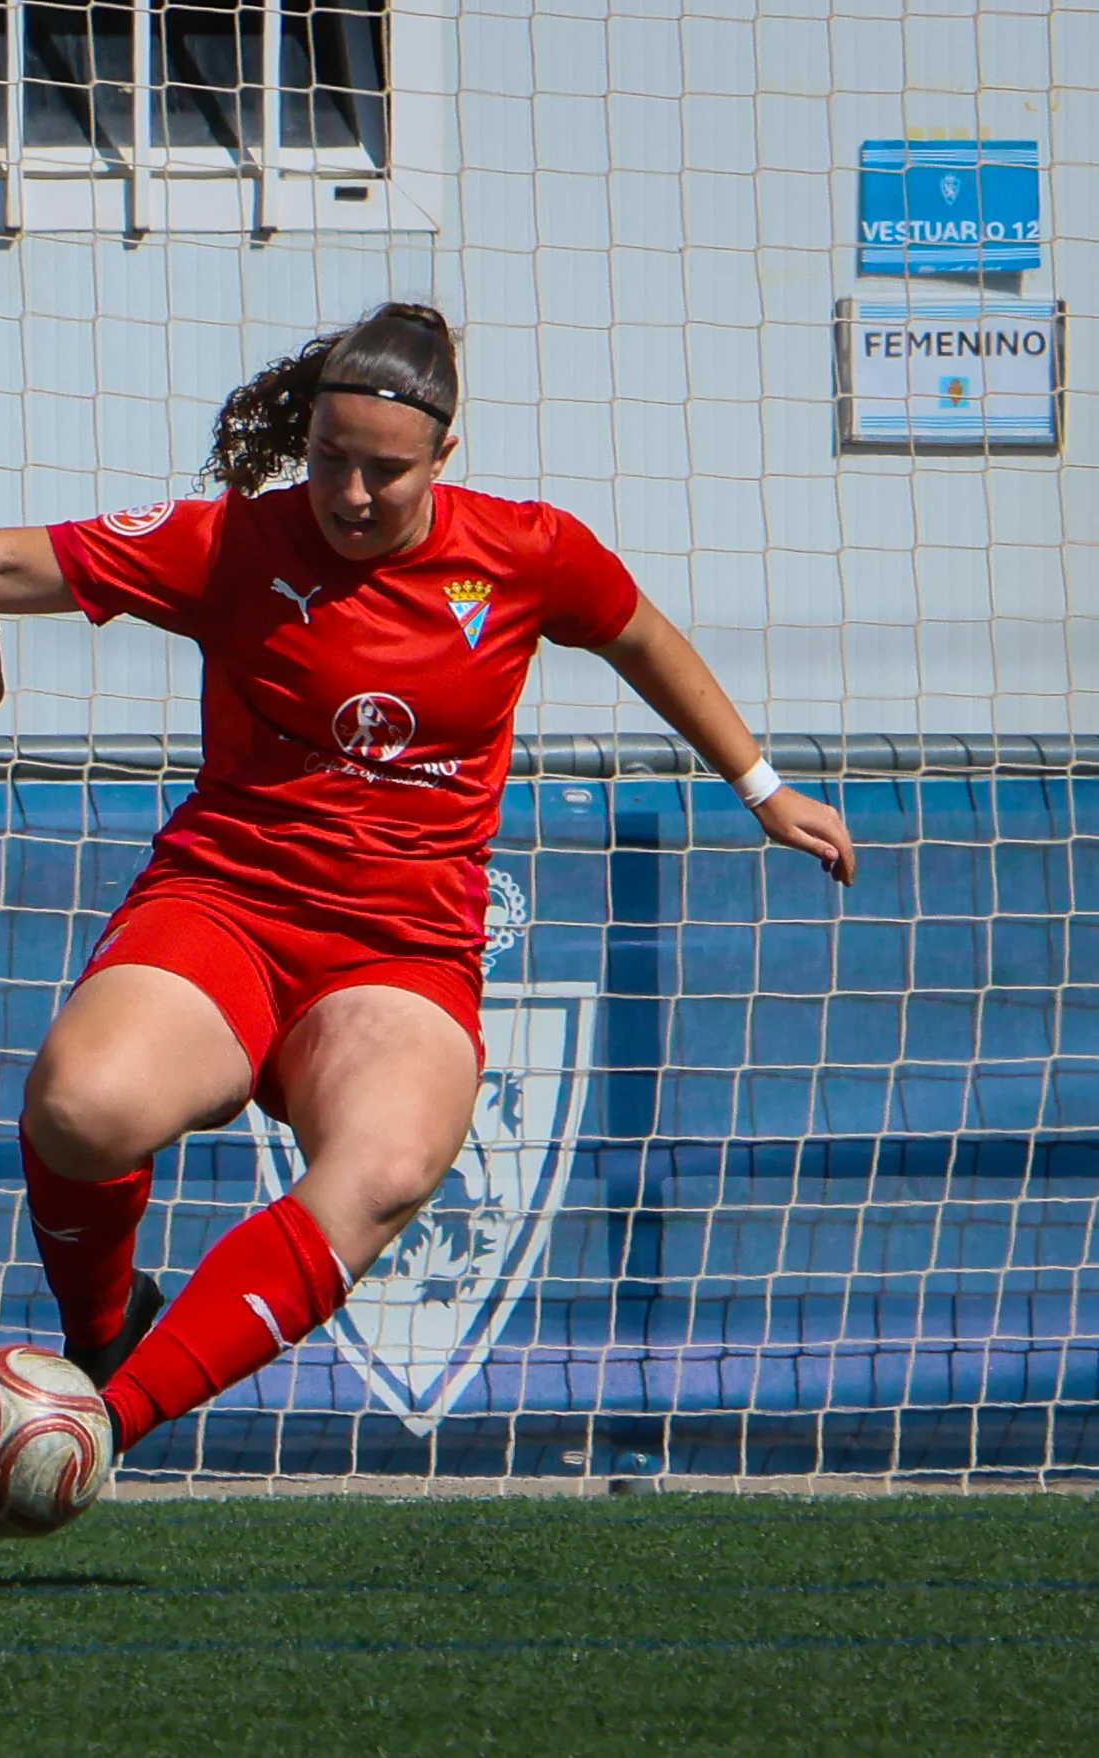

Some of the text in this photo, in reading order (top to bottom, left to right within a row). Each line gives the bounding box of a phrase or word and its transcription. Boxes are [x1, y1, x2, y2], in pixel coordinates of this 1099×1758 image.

[861, 220, 1040, 242] VESTUARO 12
[863, 331, 1047, 358] FEMENINO
